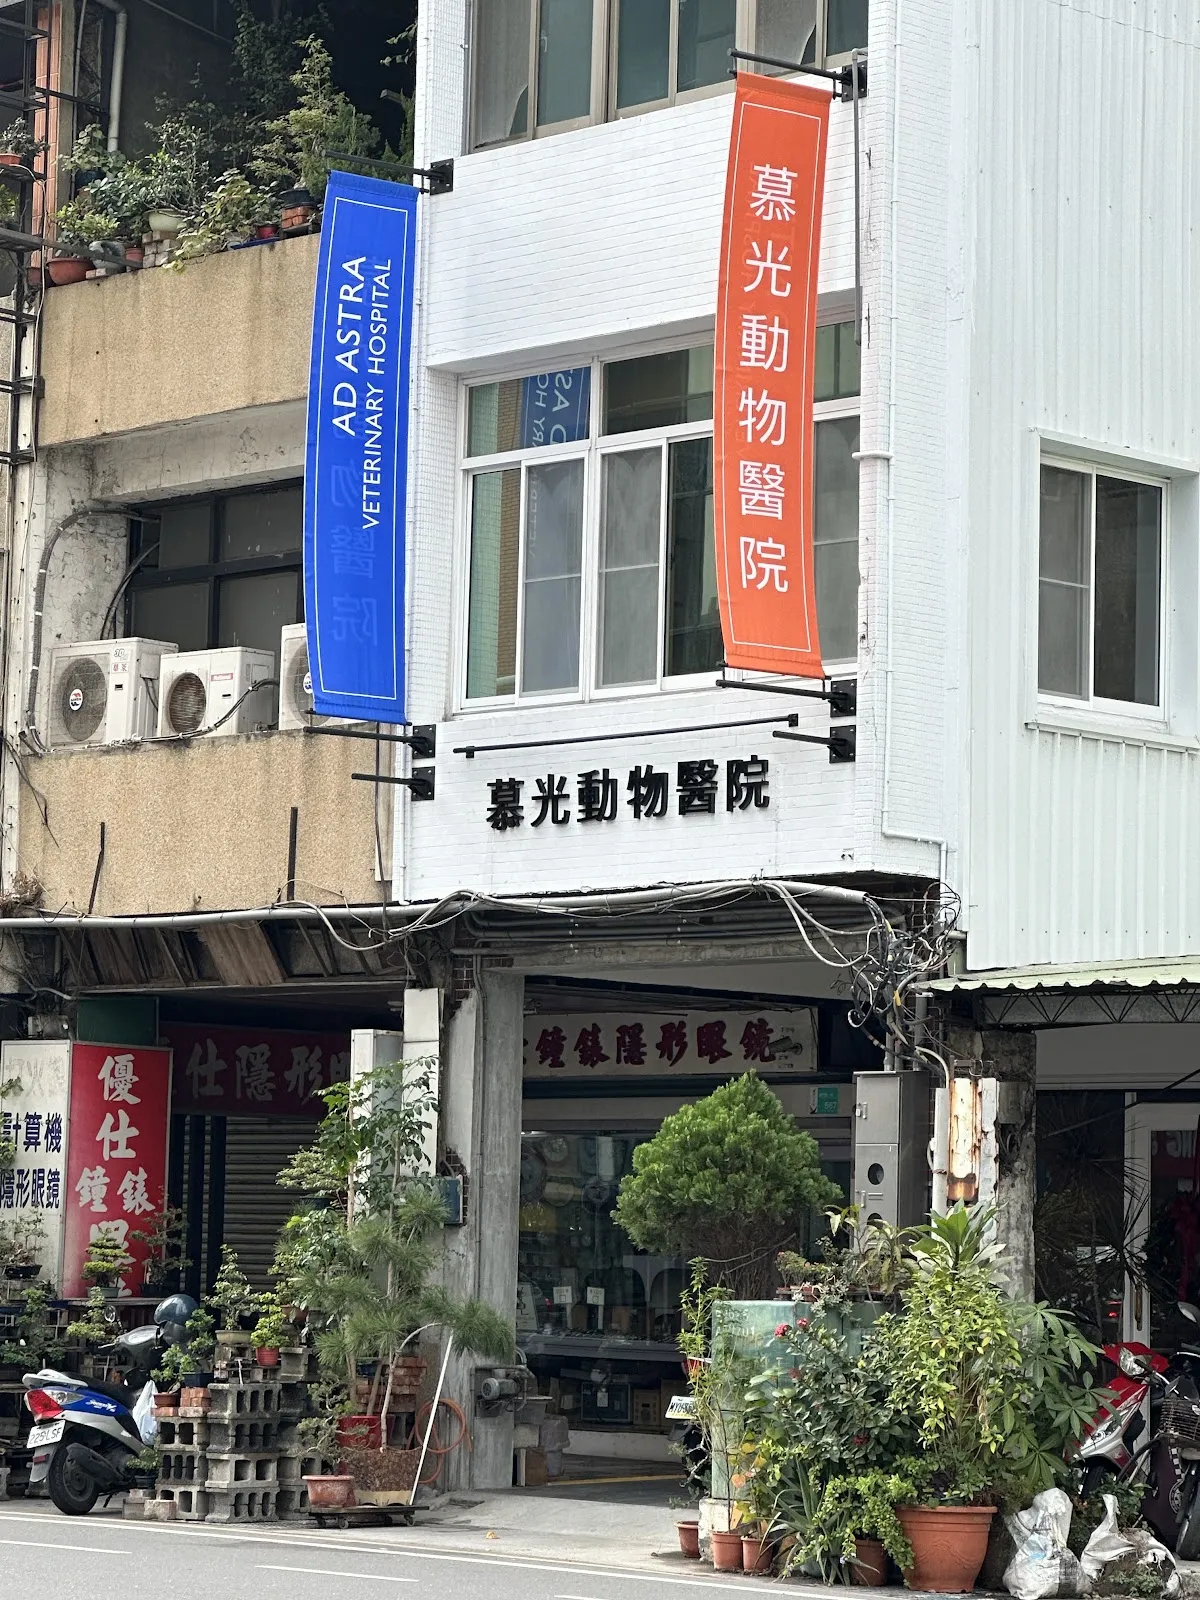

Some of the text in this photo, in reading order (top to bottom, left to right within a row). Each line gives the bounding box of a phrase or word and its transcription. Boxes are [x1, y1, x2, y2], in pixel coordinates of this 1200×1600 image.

[332, 256, 367, 436] AD ASTRA
[738, 163, 798, 593] 慕光動物醫院
[362, 259, 391, 530] VETERINARY HOSPITAL
[486, 754, 770, 831] 慕光動物醫院
[160, 1036, 351, 1106] 仕隱形
[523, 1018, 776, 1069] 鐘錶隱形眼鏡
[2, 1111, 63, 1154] 計算機
[95, 1053, 142, 1162] 優仕
[0, 1167, 60, 1210] 隱形眼鏡
[75, 1165, 156, 1216] 鐘錶
